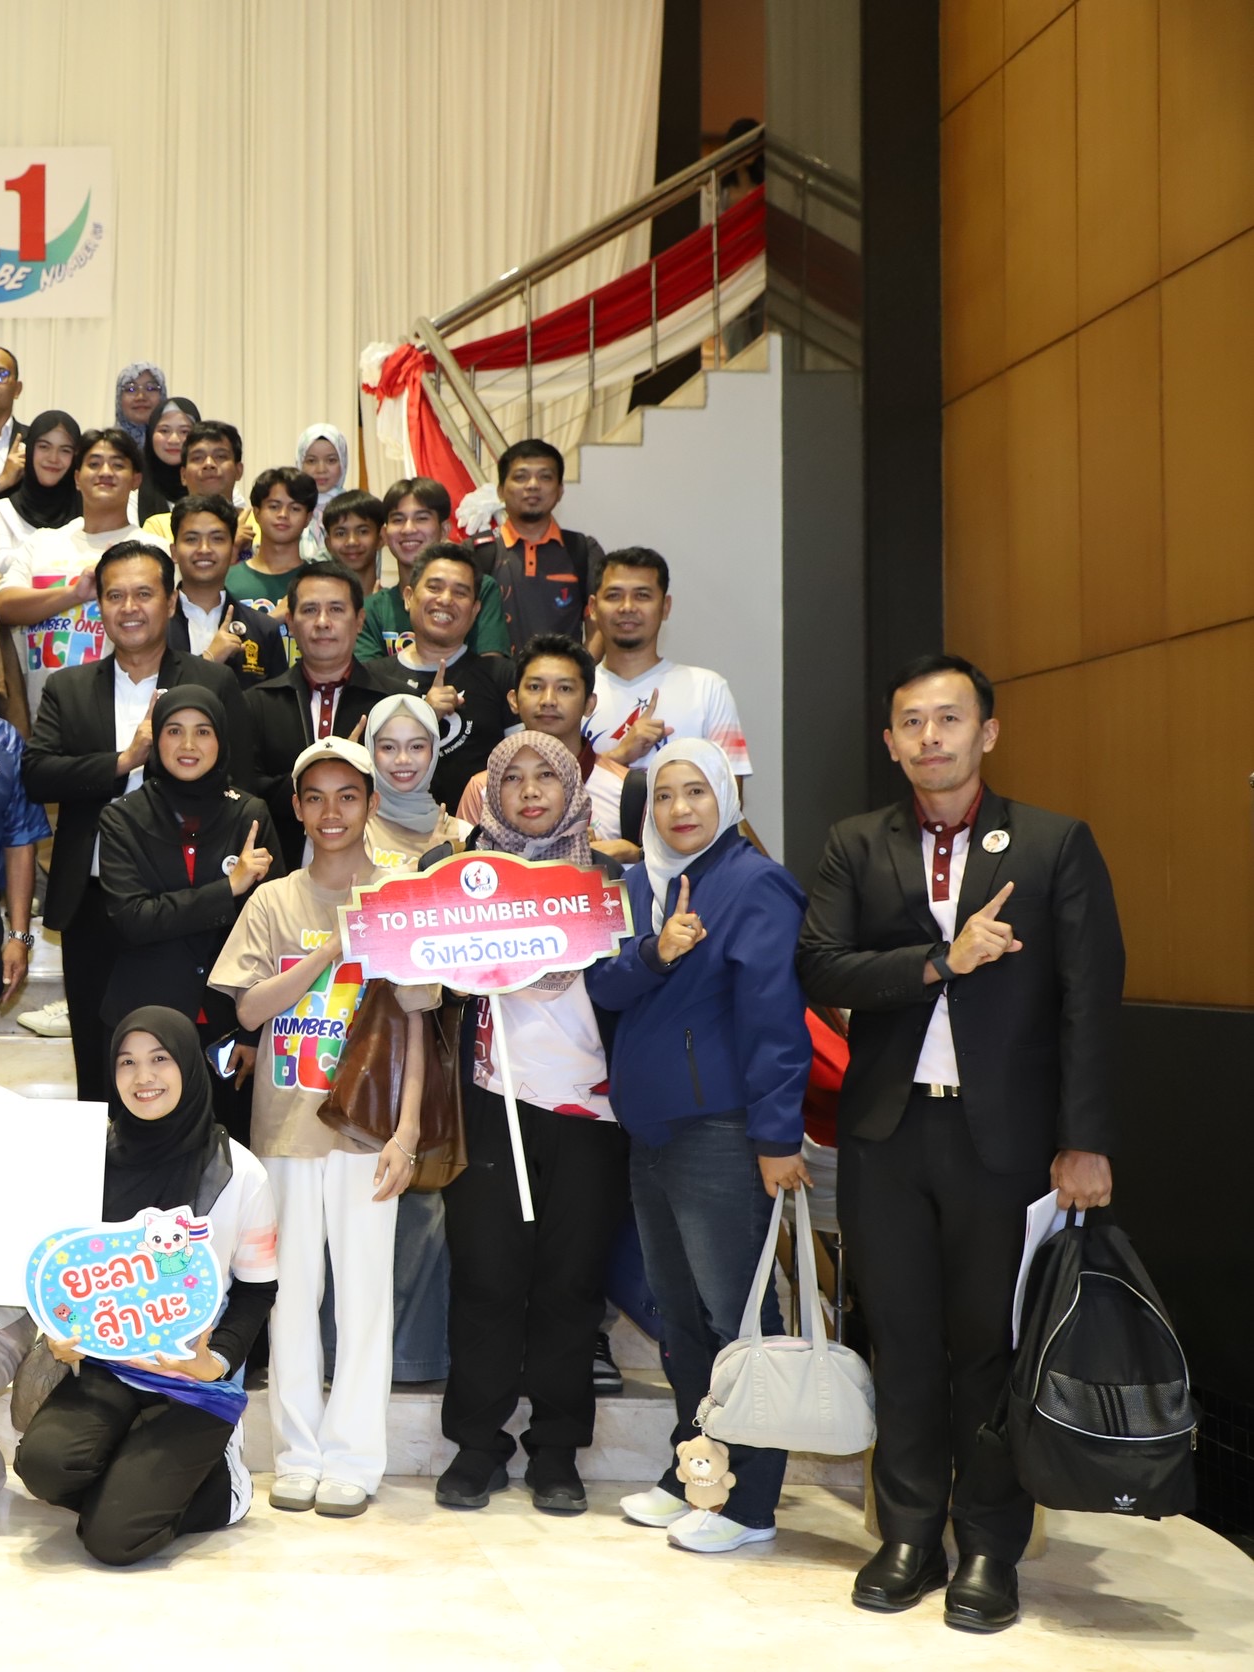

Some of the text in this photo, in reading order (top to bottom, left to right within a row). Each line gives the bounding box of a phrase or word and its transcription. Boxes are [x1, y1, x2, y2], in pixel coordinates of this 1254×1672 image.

[4, 163, 46, 262] 1
[39, 238, 99, 292] NUMBER
[74, 618, 105, 635] ONE
[464, 720, 473, 735] ONE
[378, 895, 591, 932] TO BE NUMBER ONE
[421, 936, 559, 966] จังหวัดยะลา
[273, 1018, 344, 1039] NUMBER
[62, 1254, 155, 1298] ยะลา
